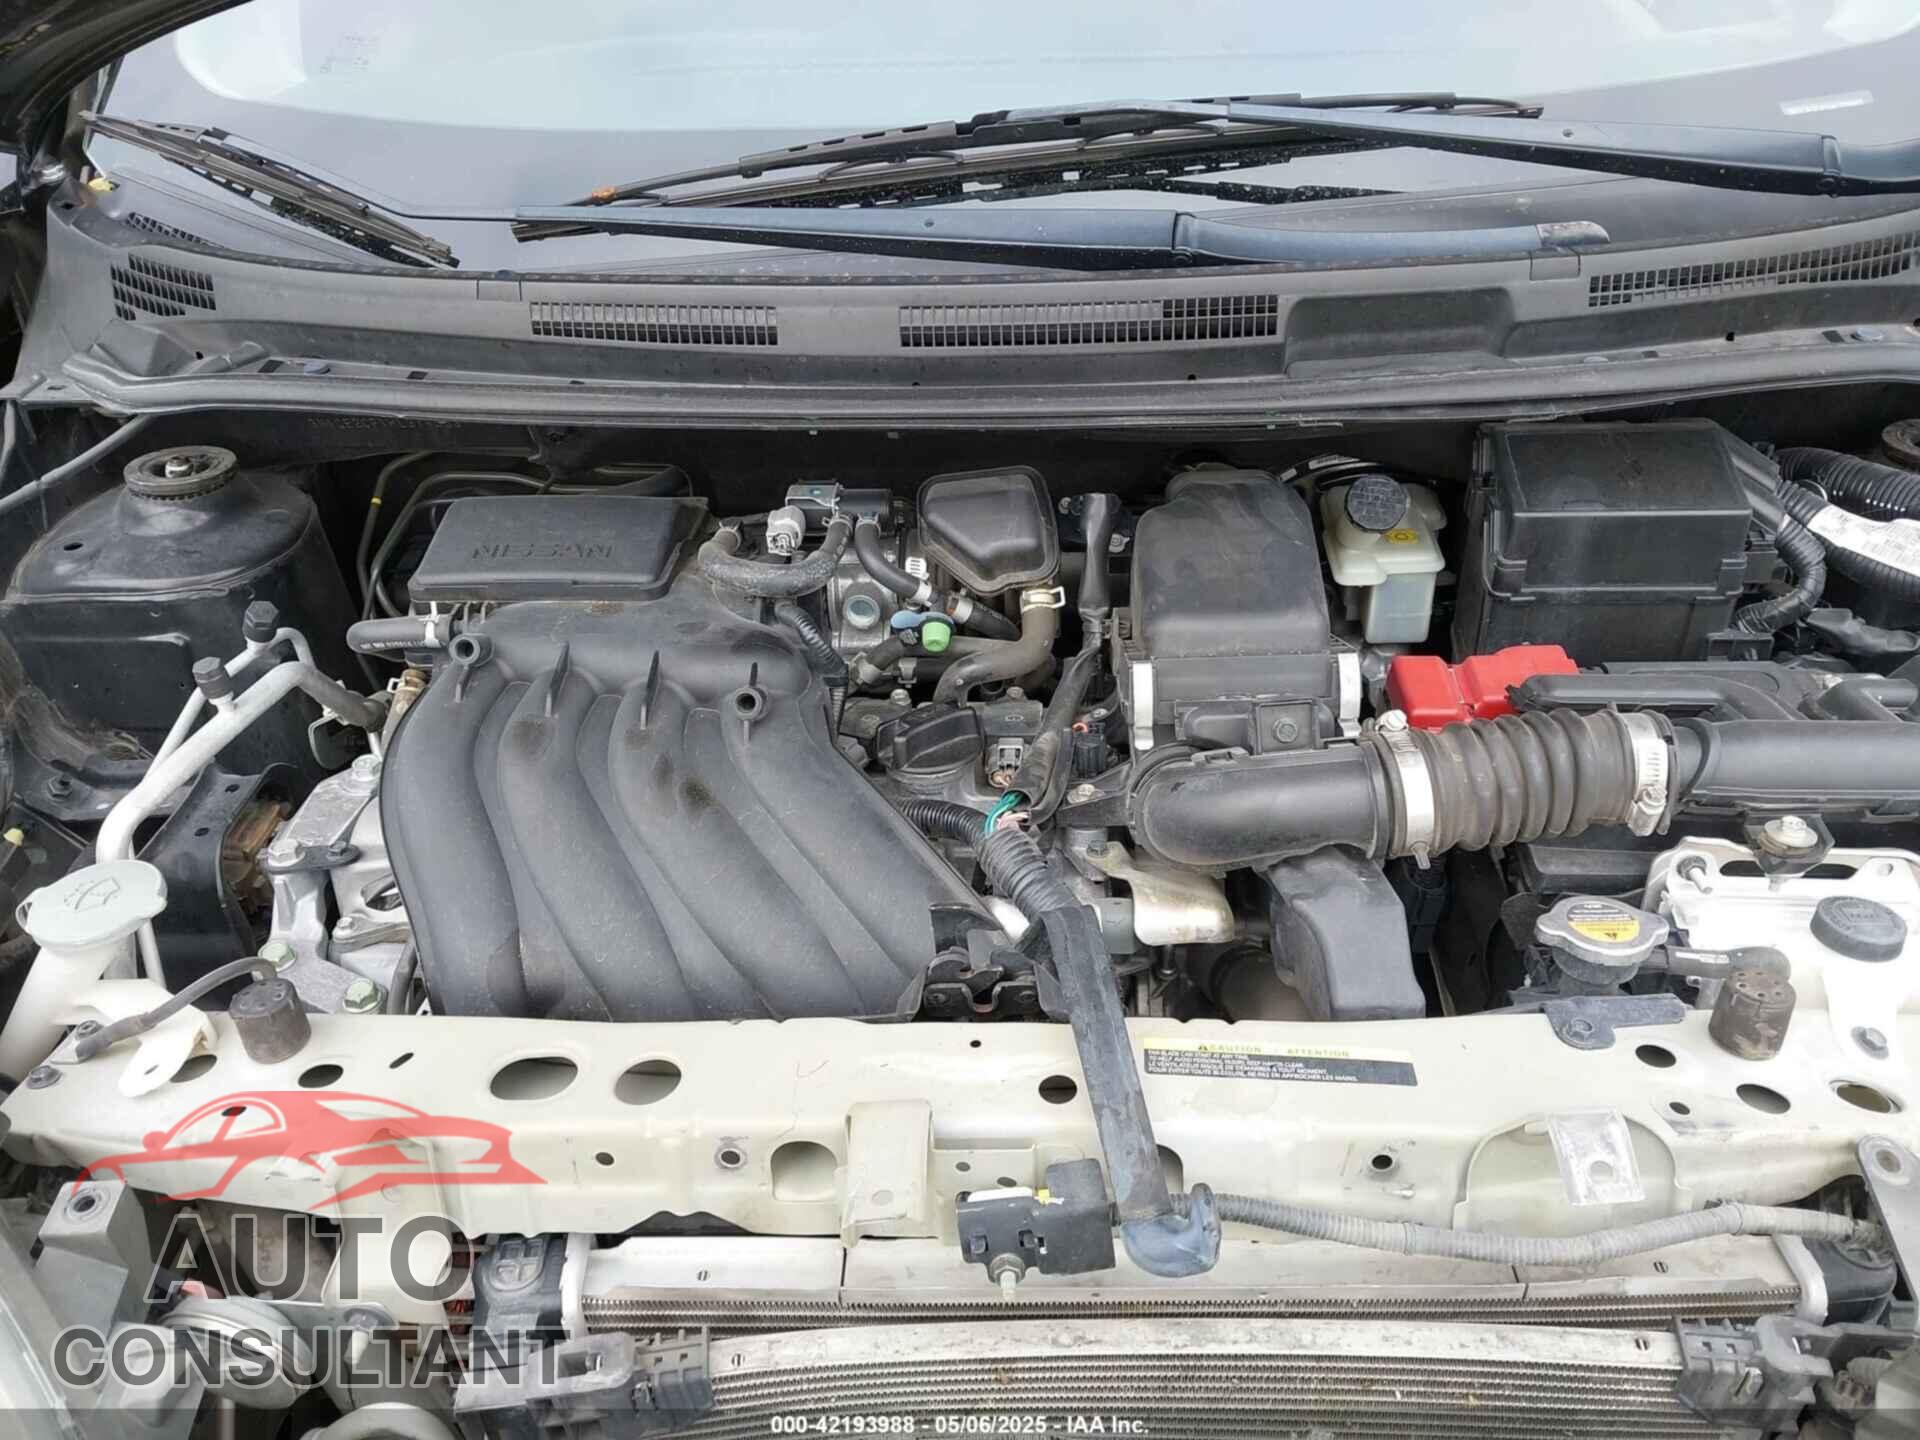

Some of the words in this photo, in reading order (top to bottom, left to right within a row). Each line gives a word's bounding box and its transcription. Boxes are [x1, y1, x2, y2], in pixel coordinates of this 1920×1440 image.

[471, 543, 613, 559] NISSAN
[1209, 1045, 1261, 1053] CAUTION
[1287, 1049, 1349, 1057] ATTENTION
